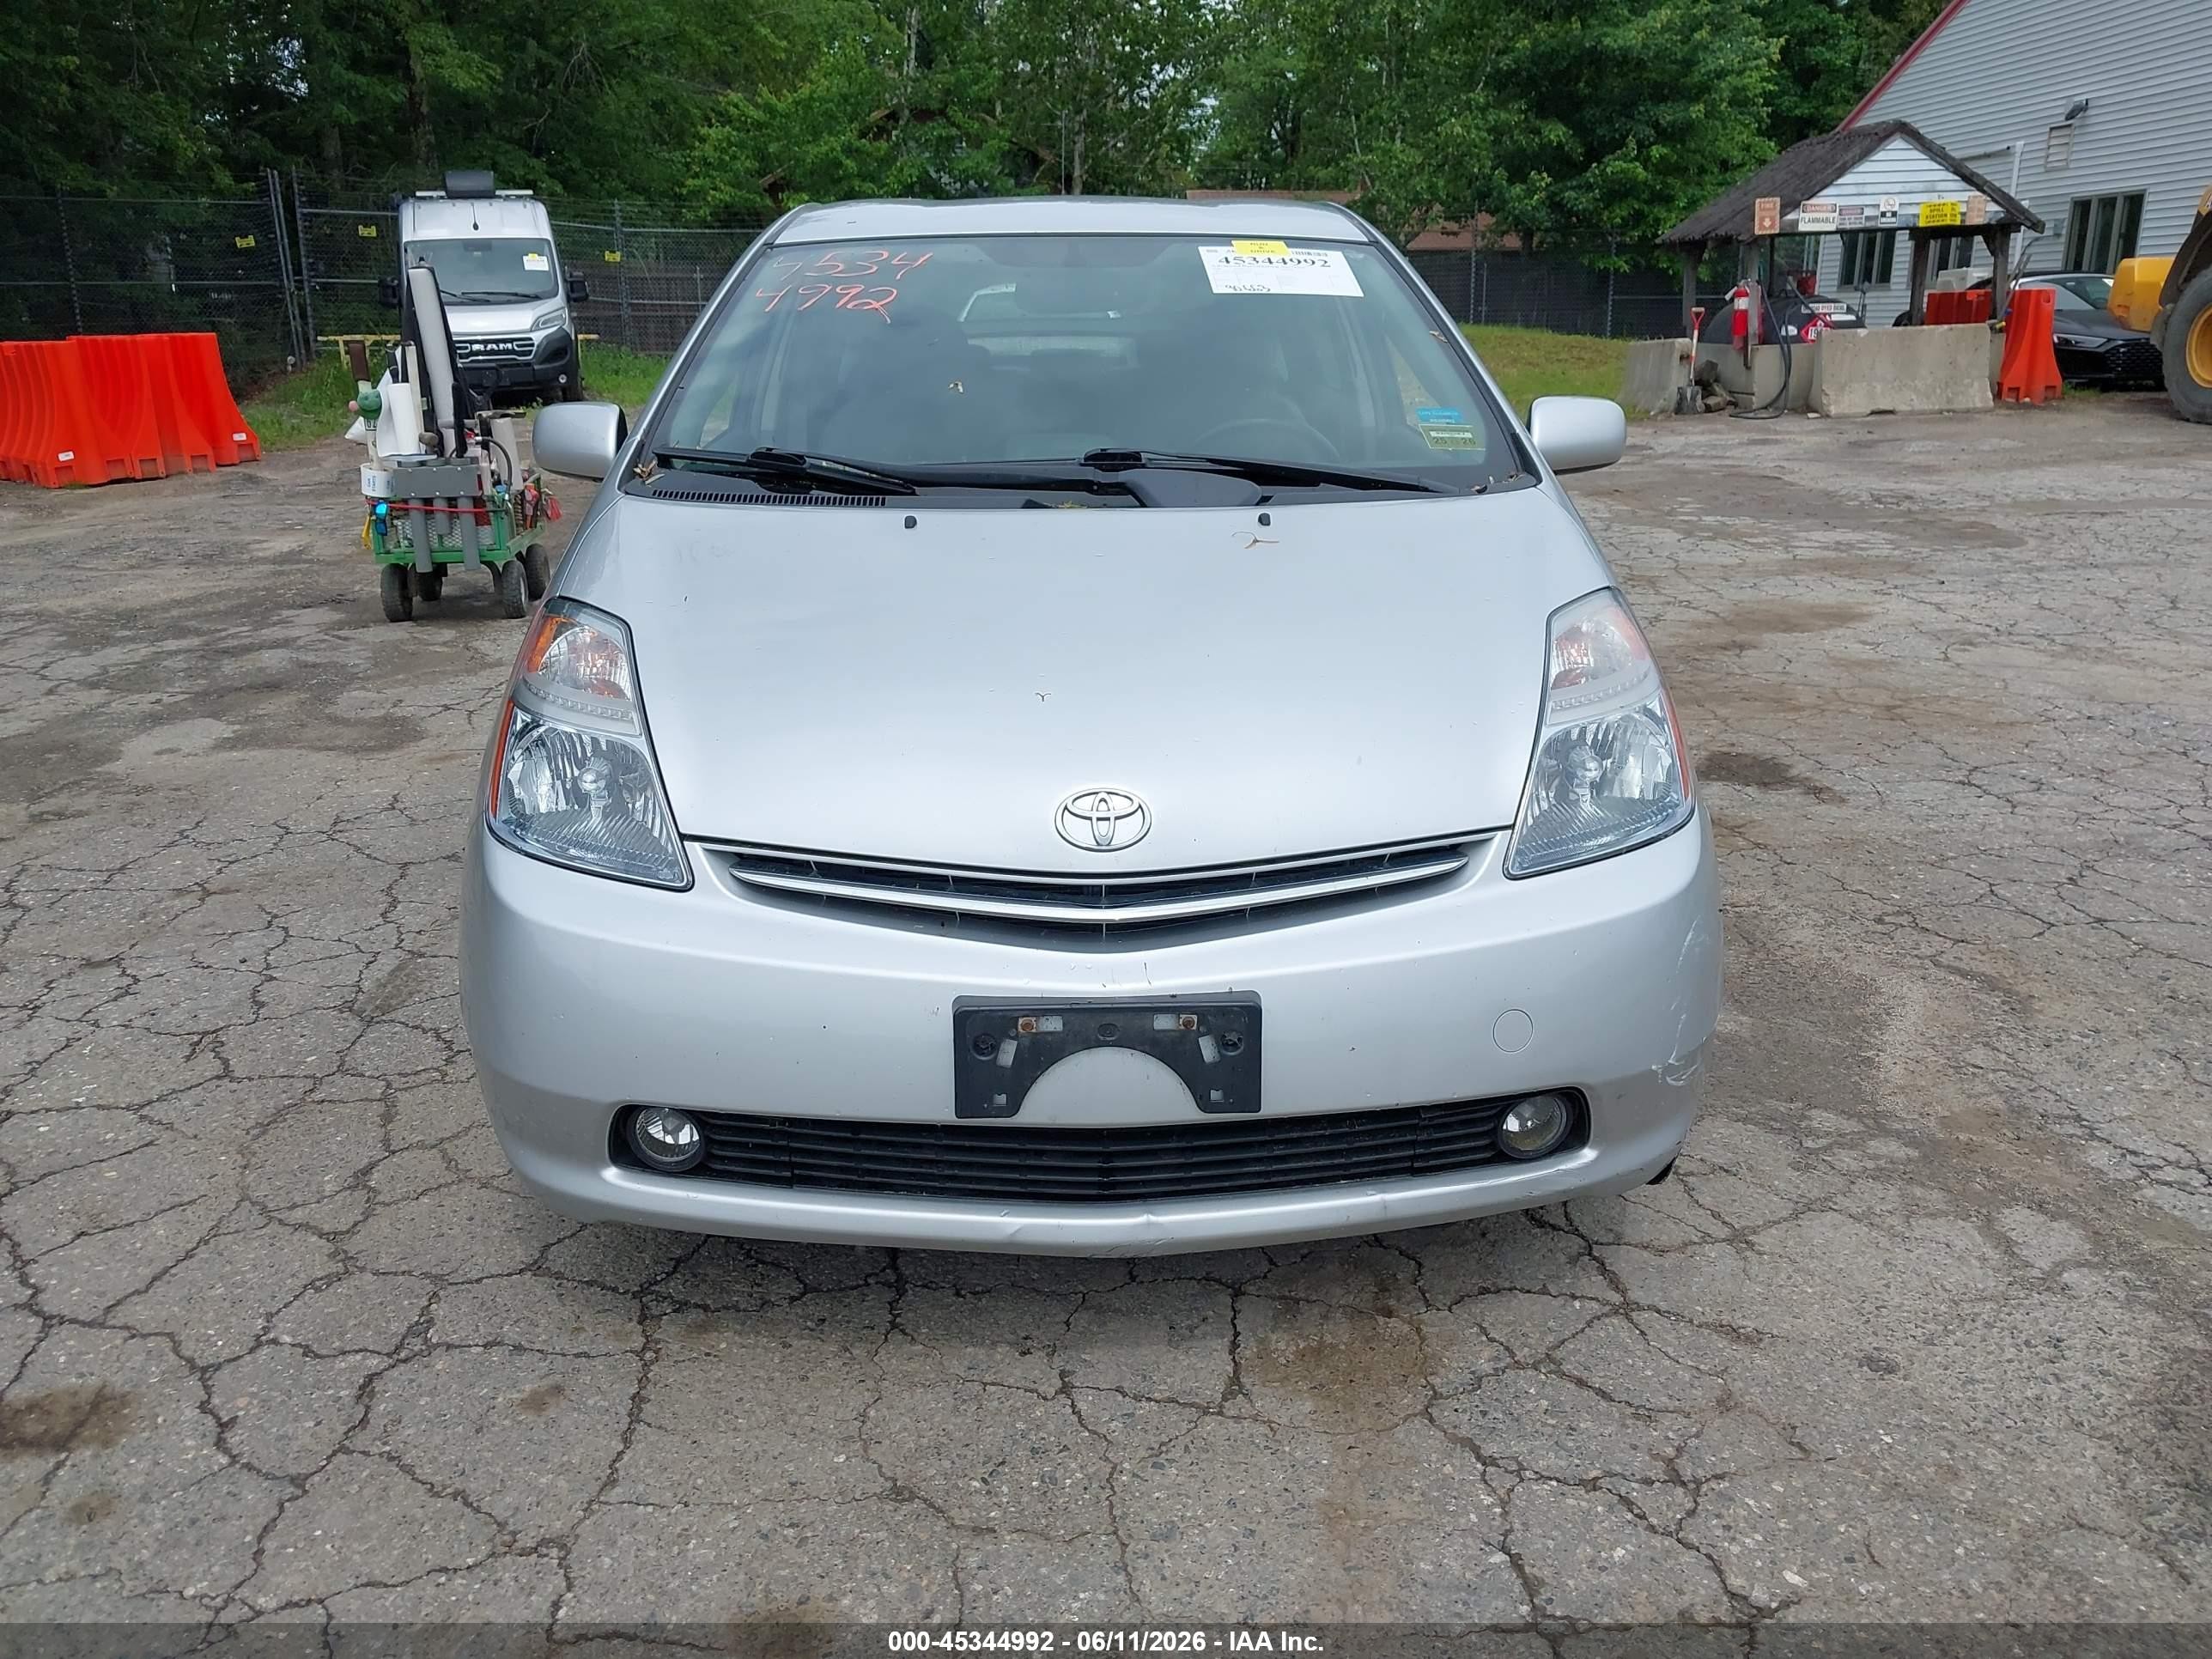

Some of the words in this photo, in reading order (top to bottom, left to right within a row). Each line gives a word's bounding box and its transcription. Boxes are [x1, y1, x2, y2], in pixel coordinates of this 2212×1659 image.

[1801, 216, 1836, 225] FLAMMABLE
[1218, 256, 1331, 268] 45344992
[756, 284, 898, 324] 4992
